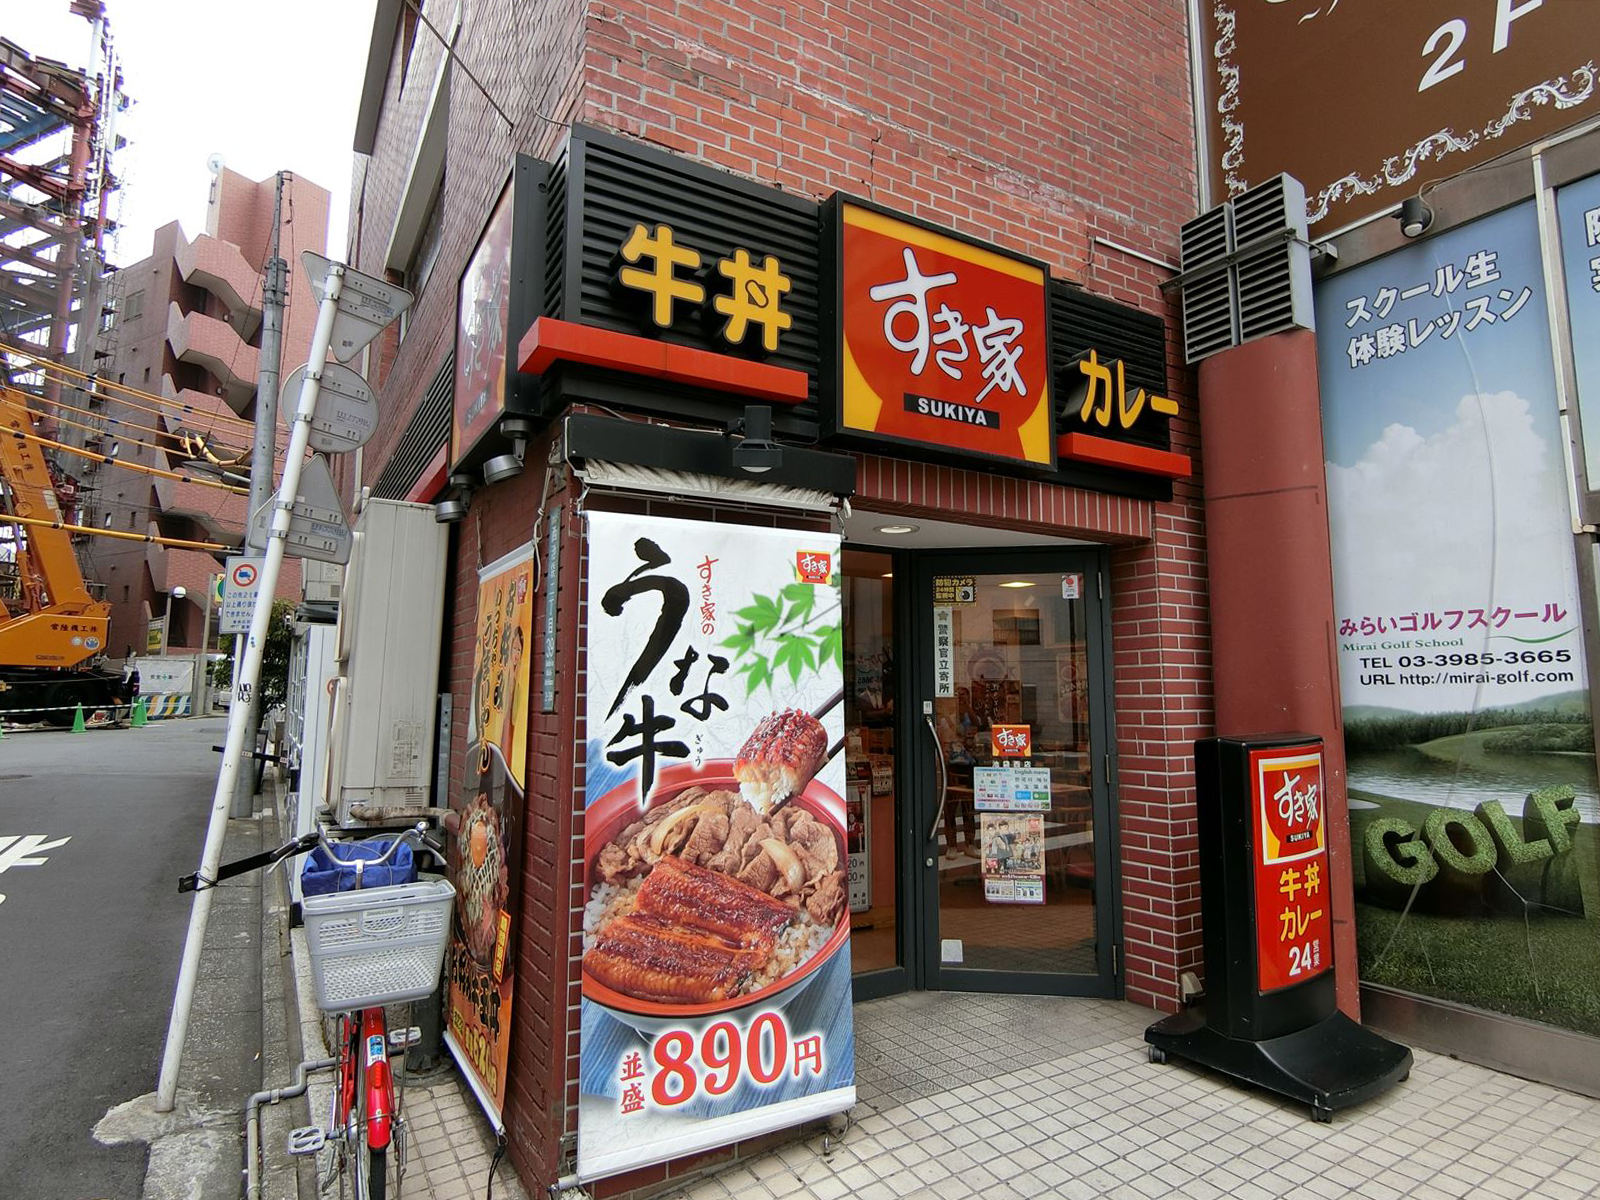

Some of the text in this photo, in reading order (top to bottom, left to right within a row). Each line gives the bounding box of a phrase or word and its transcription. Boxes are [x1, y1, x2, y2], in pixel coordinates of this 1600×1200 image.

[619, 222, 793, 353] 牛丼
[1346, 250, 1501, 328] スクール生
[869, 247, 1028, 404] すき家
[1347, 286, 1532, 369] 体験レッスン
[917, 397, 989, 427] SUKIYA
[1078, 348, 1180, 430] カレー
[800, 553, 828, 576] すき家
[696, 555, 719, 636] すき家の
[1338, 602, 1568, 637] みらいゴルフスクール
[937, 624, 950, 694] 警察官立寄所
[1341, 637, 1464, 652] Mirai Golf School
[1359, 649, 1572, 669] TEL 03-3985-3665
[1359, 669, 1574, 687] URL http://mirai-golf.com
[996, 728, 1027, 748] すき家
[1273, 771, 1319, 829] すき家
[1289, 832, 1311, 843] SUKIYA
[1364, 783, 1582, 886] GOLF
[1279, 861, 1321, 902] 牛丼
[1279, 905, 1323, 942] カレー
[1289, 942, 1312, 976] 24
[620, 1052, 645, 1114] 並盛
[651, 1012, 822, 1106] 890円
